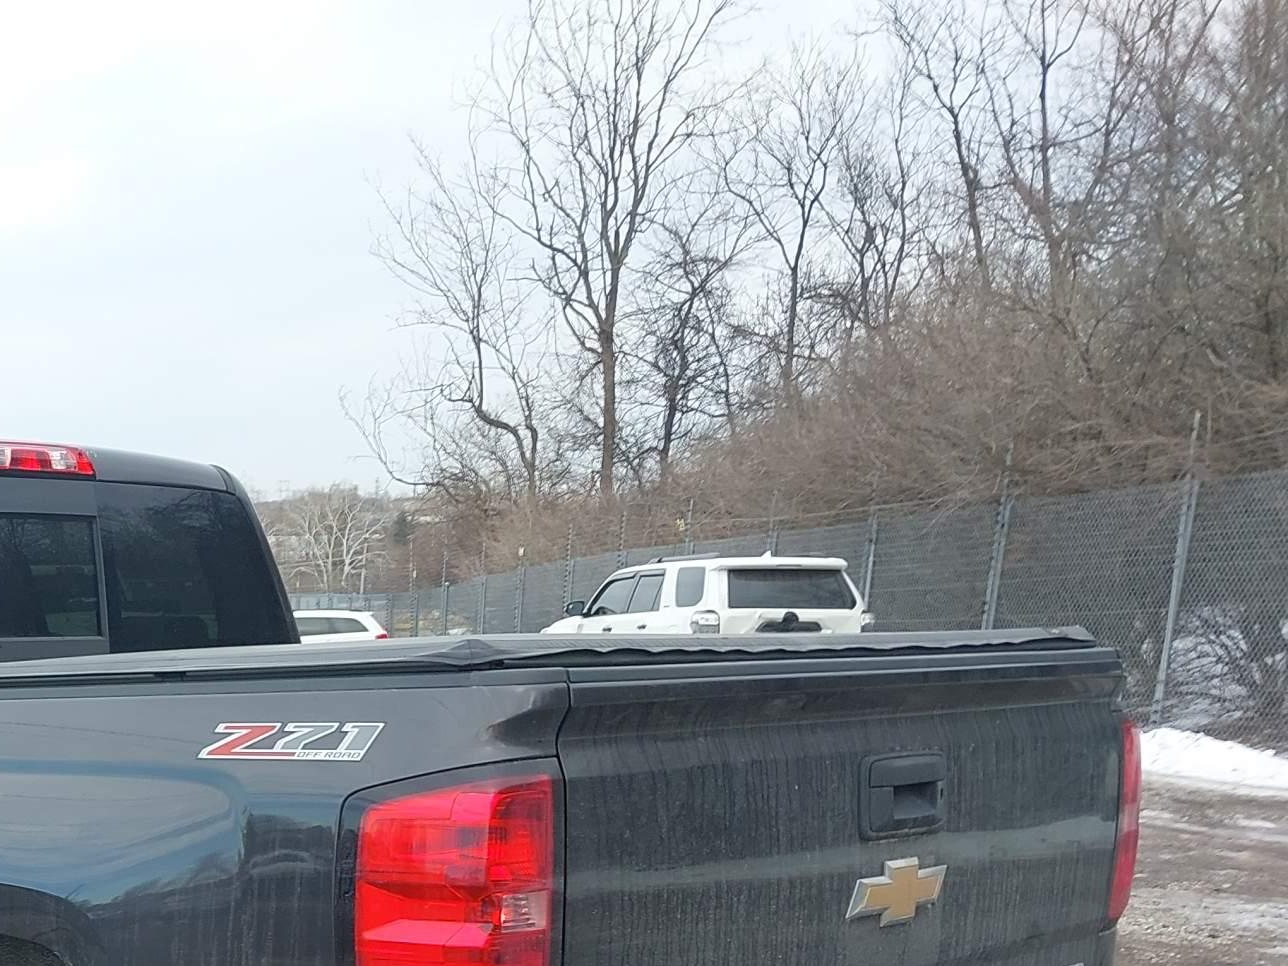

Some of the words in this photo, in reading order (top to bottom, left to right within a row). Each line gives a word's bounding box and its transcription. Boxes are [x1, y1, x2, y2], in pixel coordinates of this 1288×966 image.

[197, 722, 385, 761] Z71
[296, 751, 322, 759] OFF
[323, 751, 361, 759] ROAD
